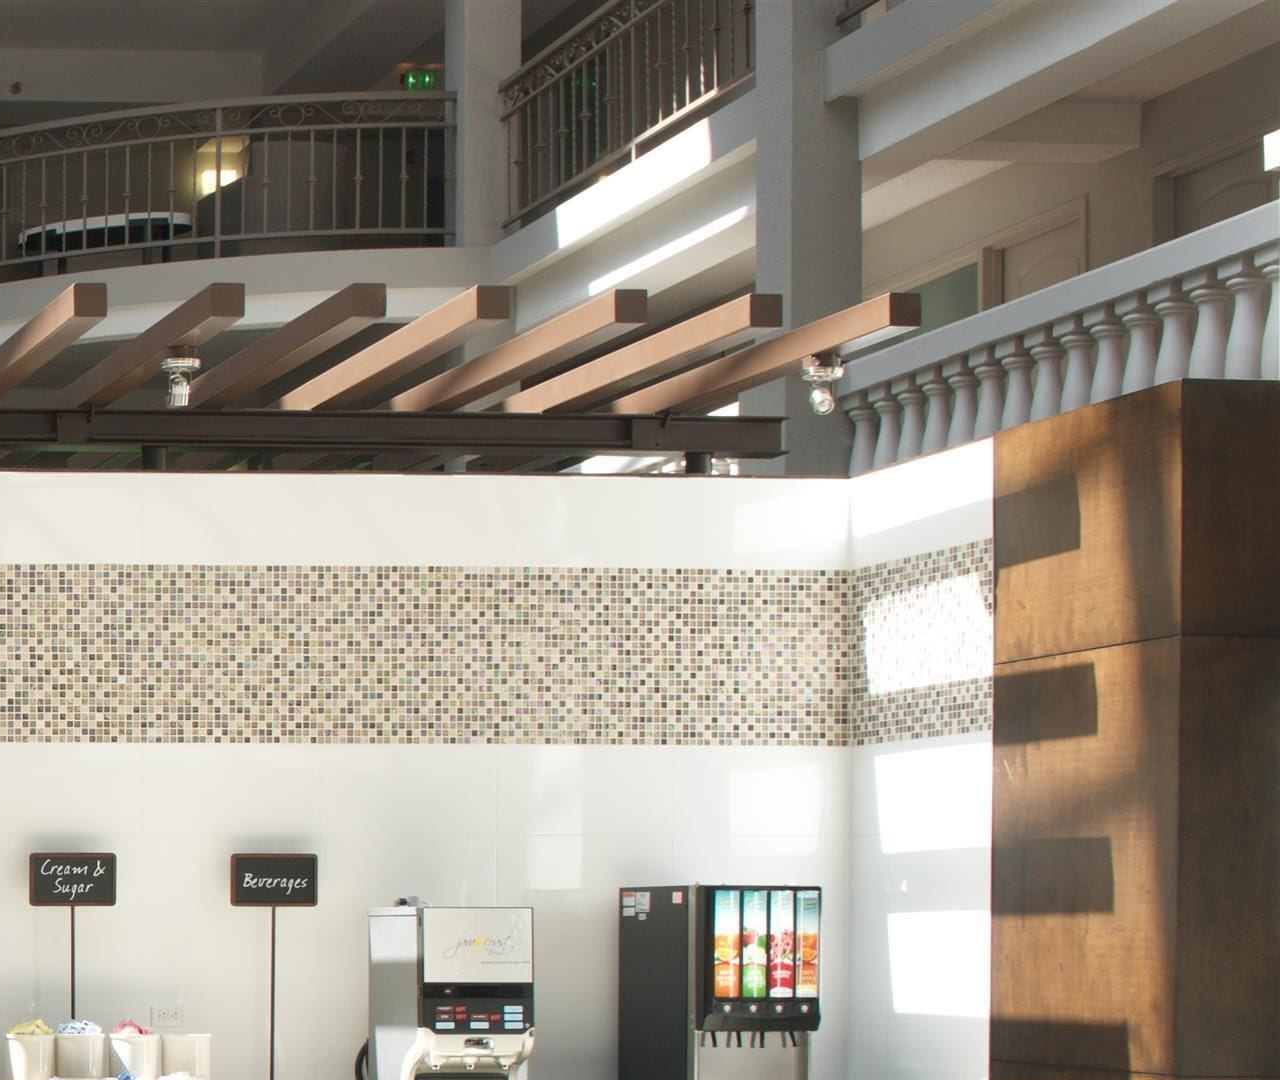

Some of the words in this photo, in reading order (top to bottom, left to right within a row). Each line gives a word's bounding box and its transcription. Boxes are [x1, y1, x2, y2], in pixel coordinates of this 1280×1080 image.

[40, 858, 88, 876] Cream
[93, 860, 106, 877] &
[52, 877, 94, 901] Sugar
[242, 872, 308, 895] Beverages
